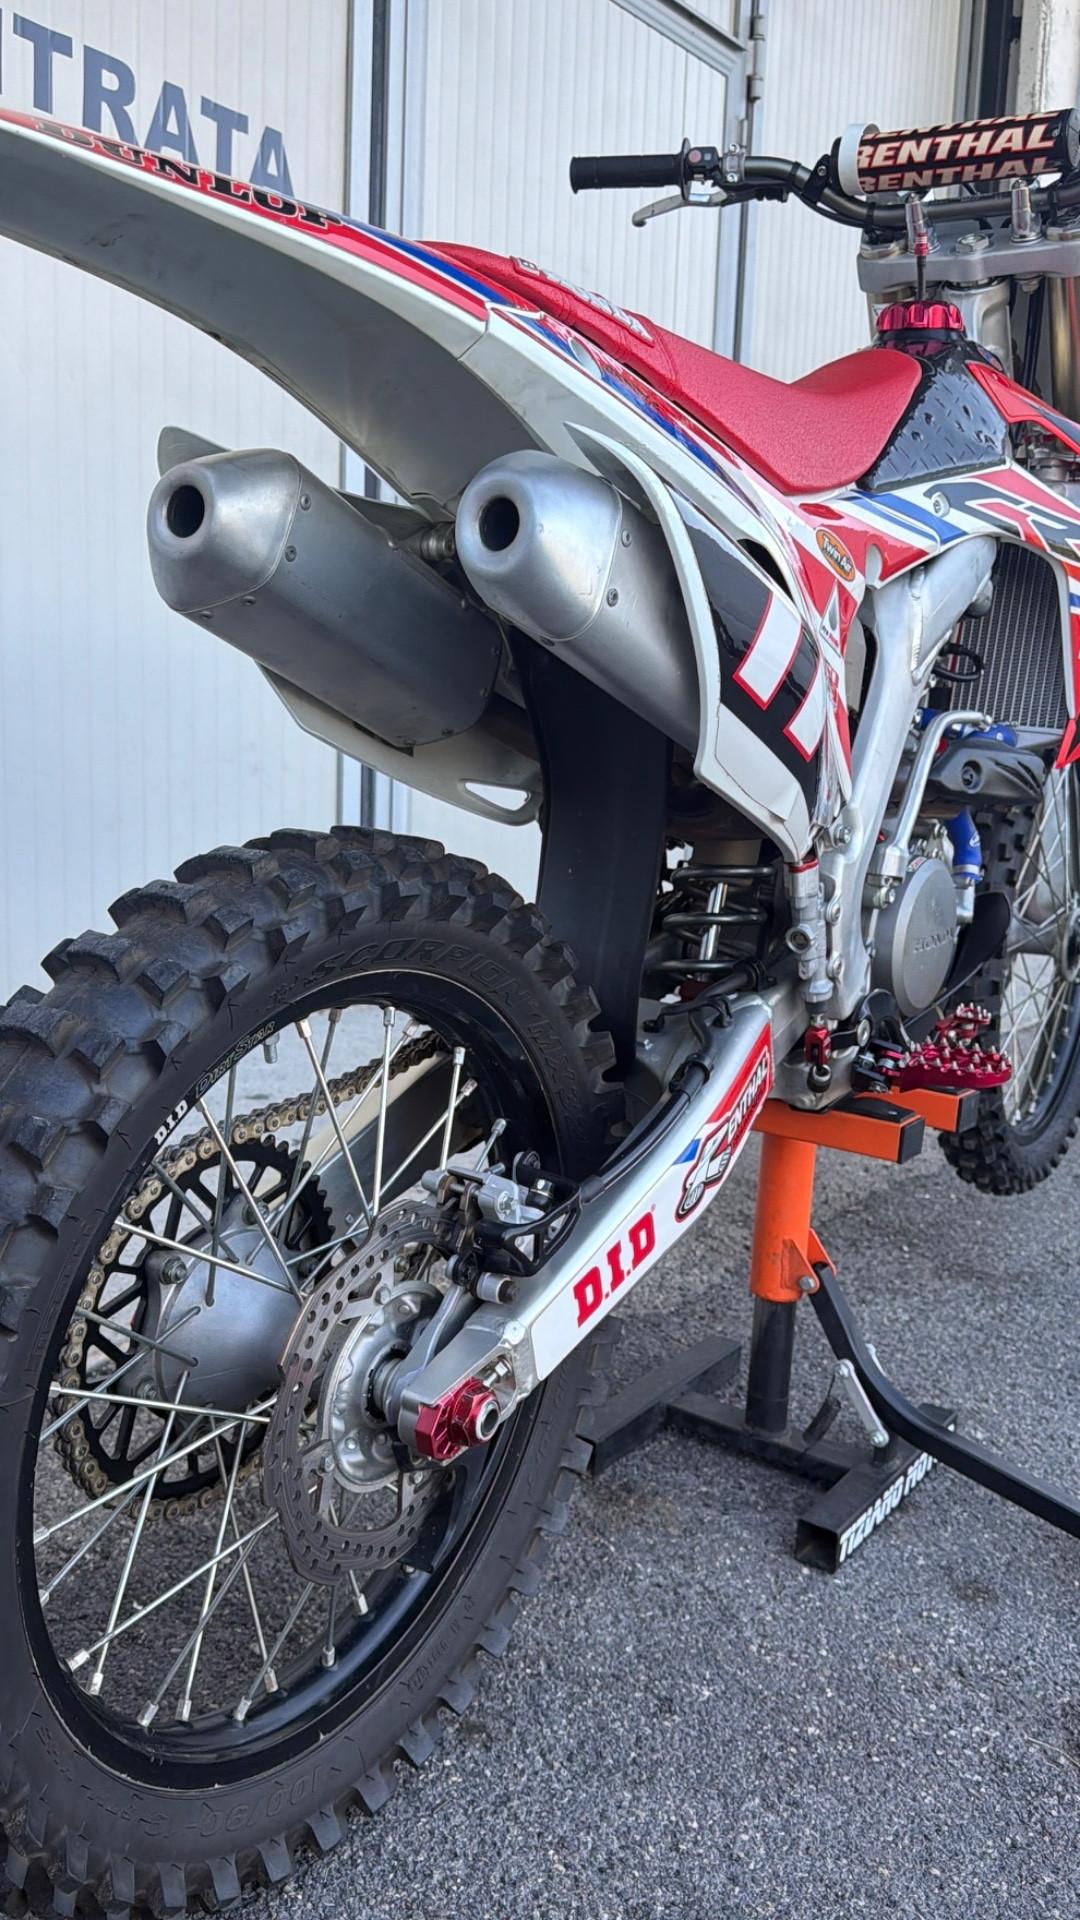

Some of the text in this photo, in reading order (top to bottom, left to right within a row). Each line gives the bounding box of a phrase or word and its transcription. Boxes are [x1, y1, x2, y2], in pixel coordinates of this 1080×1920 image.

[0, 8, 295, 198] TRATA
[34, 118, 342, 229] DUNLOP
[823, 534, 853, 574] Twin Air
[154, 1100, 189, 1146] D.I.D
[573, 1211, 656, 1329] D.I.D
